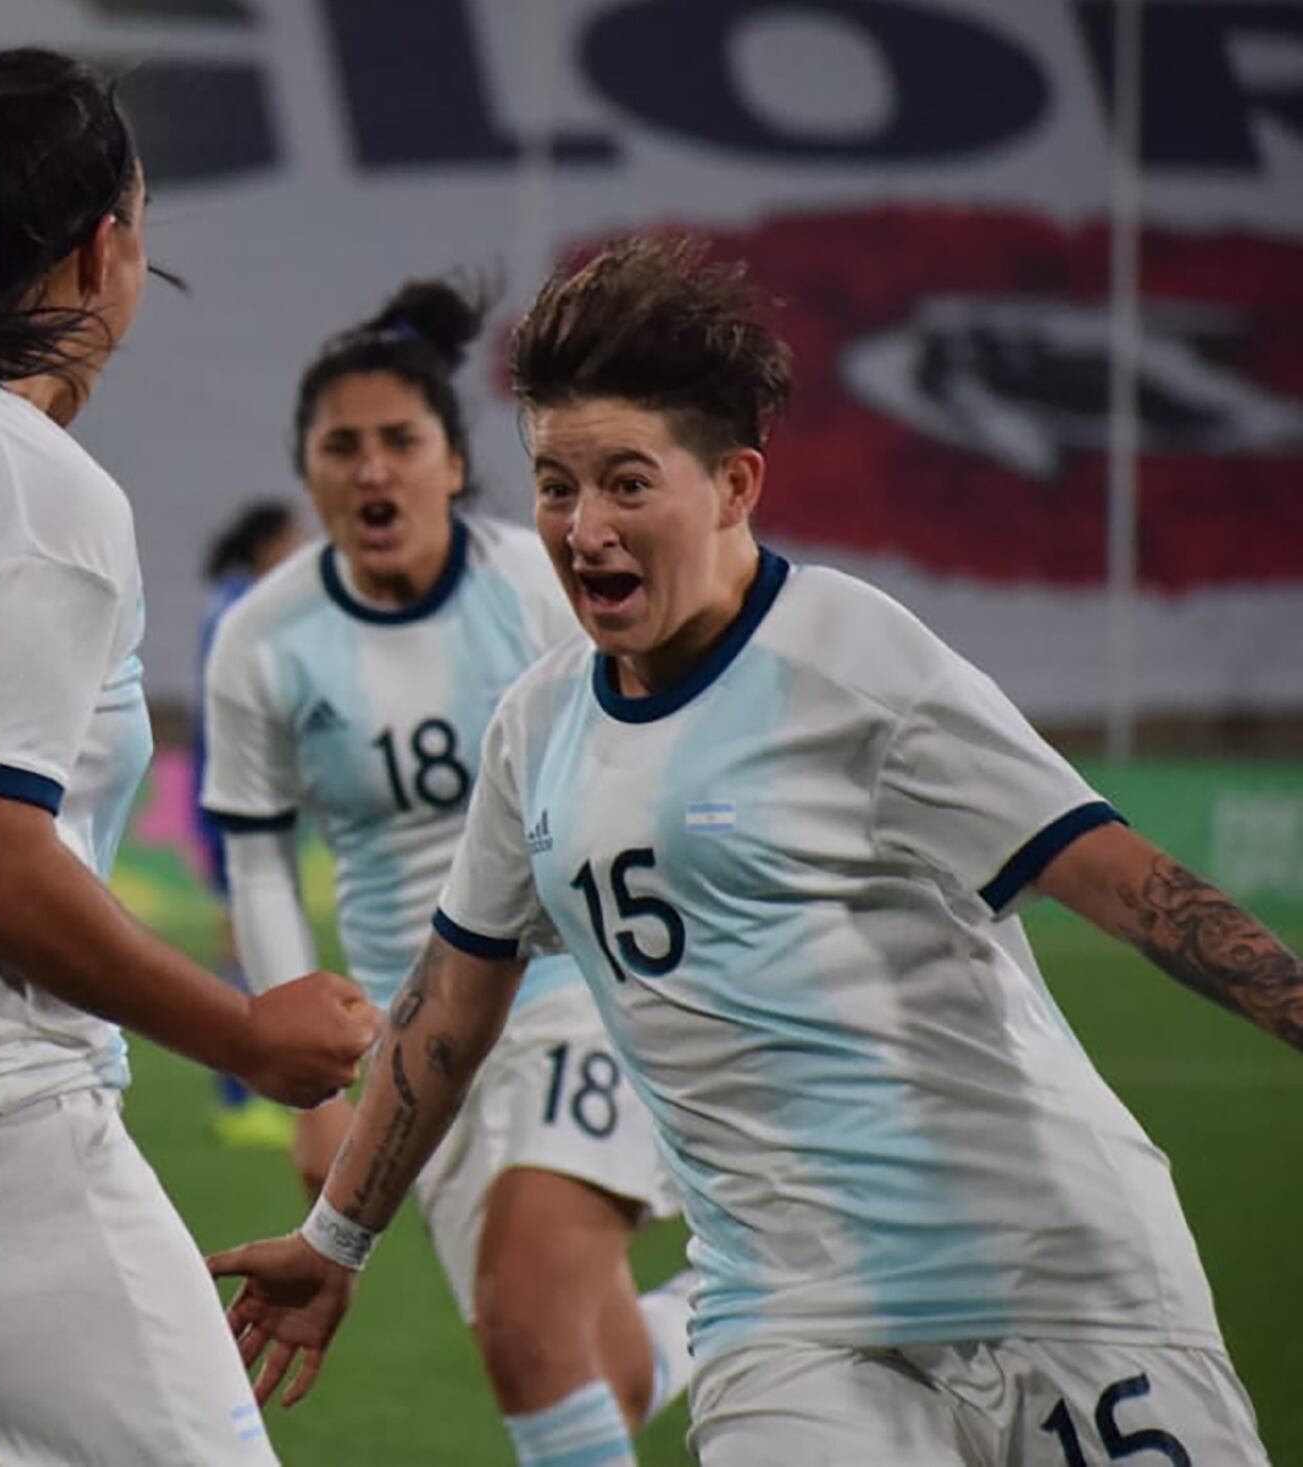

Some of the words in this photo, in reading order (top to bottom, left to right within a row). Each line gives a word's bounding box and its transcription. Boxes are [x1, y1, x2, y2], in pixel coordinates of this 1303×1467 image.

[373, 719, 470, 812] 18
[570, 848, 685, 983] 15
[543, 1041, 620, 1139] 18
[1040, 1373, 1191, 1467] 15
